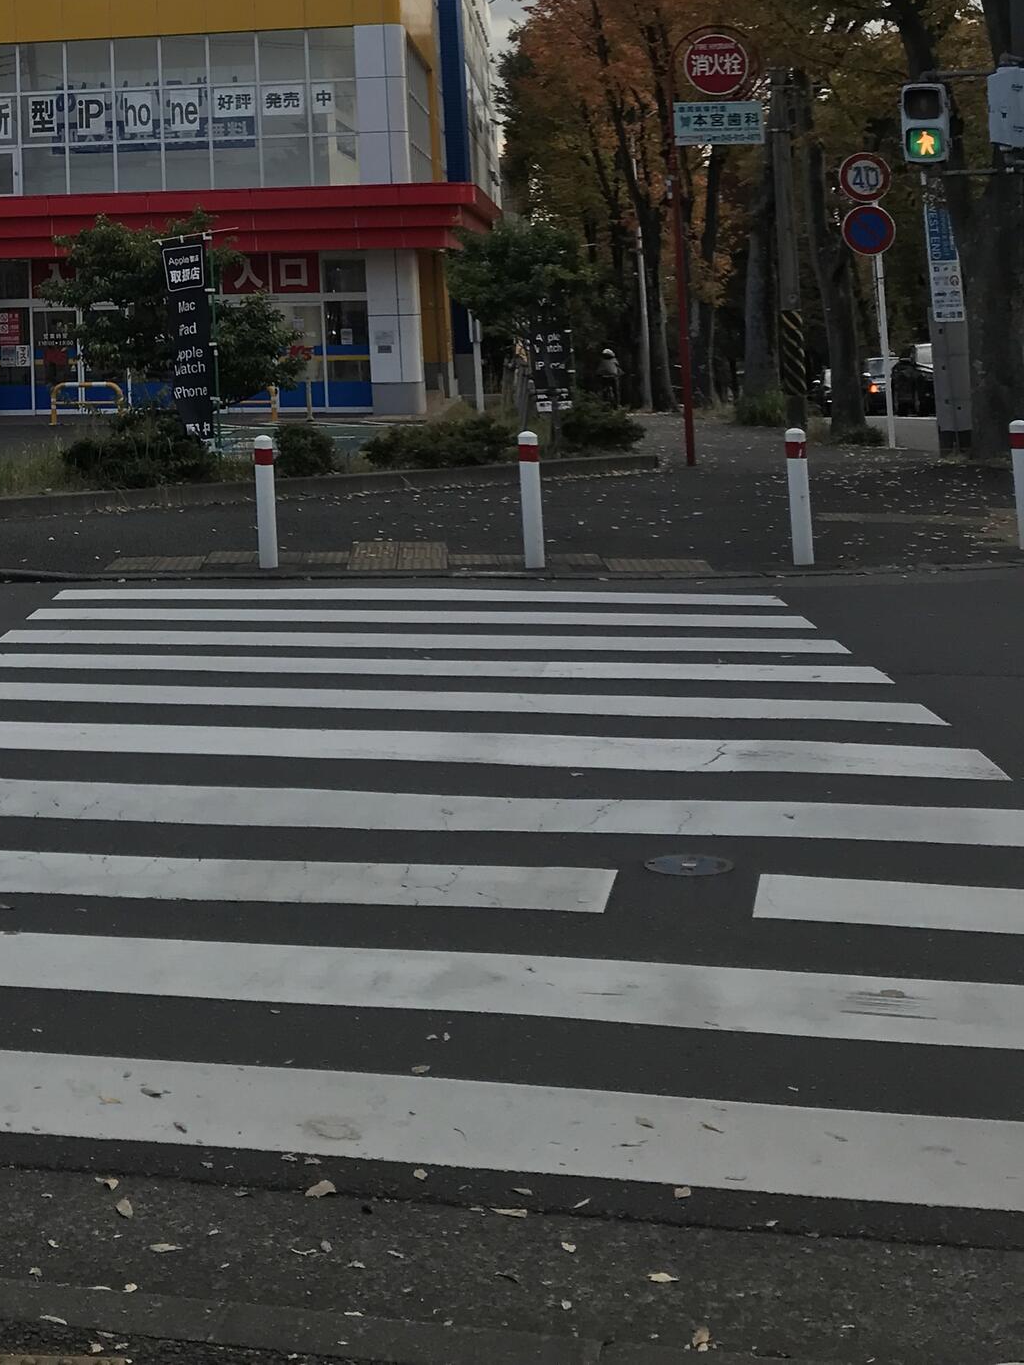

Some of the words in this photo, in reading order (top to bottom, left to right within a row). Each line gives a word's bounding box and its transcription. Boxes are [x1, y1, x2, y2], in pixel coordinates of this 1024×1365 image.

[690, 52, 745, 77] 消火栓
[692, 113, 760, 127] 本宮歯科
[853, 166, 879, 188] 40
[233, 257, 309, 289] 入口
[178, 301, 197, 314] Mac
